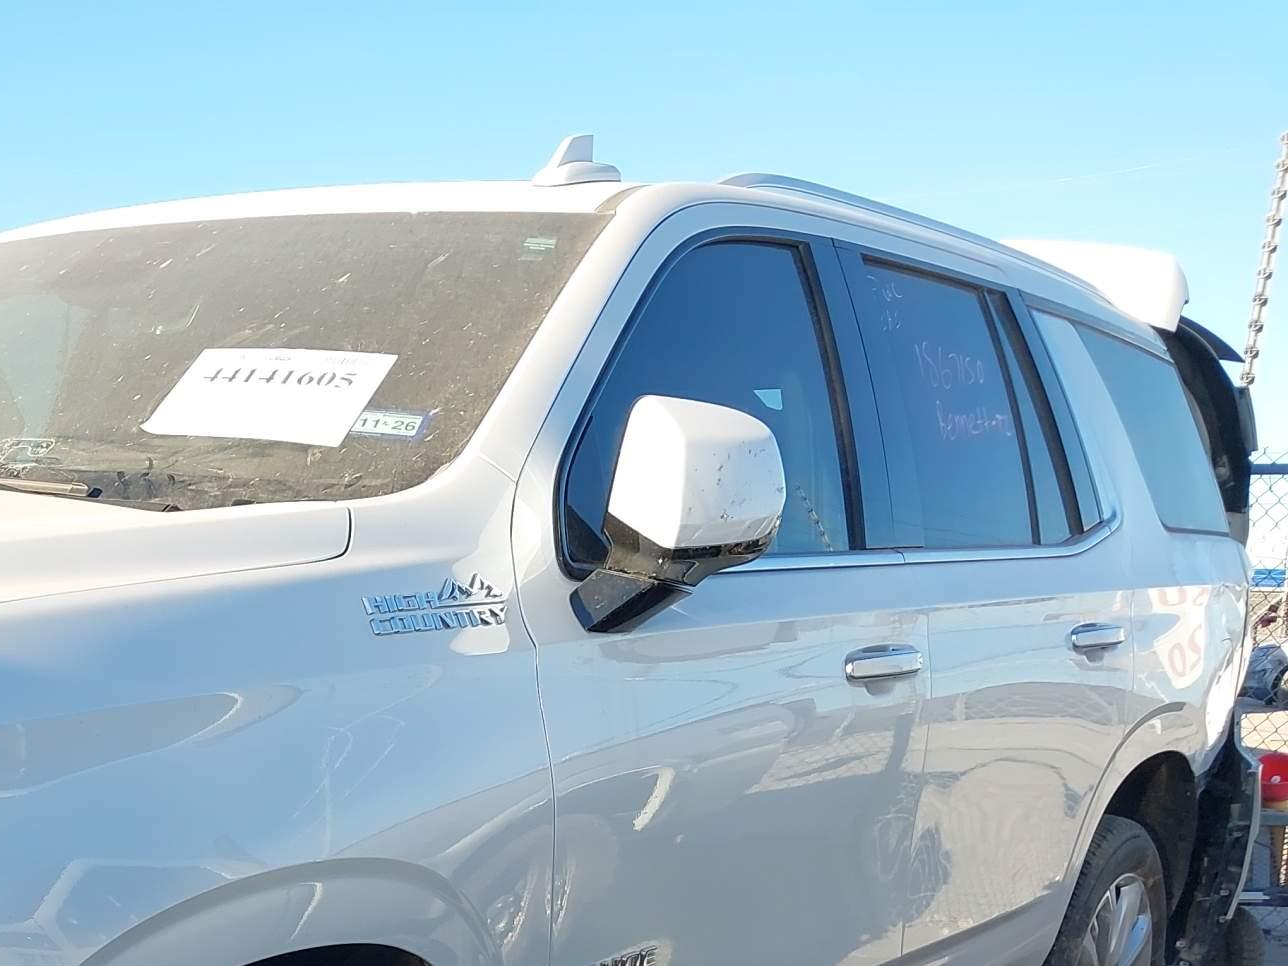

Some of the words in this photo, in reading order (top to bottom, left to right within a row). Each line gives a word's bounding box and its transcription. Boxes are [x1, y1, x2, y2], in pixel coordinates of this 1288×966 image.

[203, 368, 358, 389] 44141605
[362, 592, 440, 616] HIGH
[370, 606, 508, 636] COUNTRY
